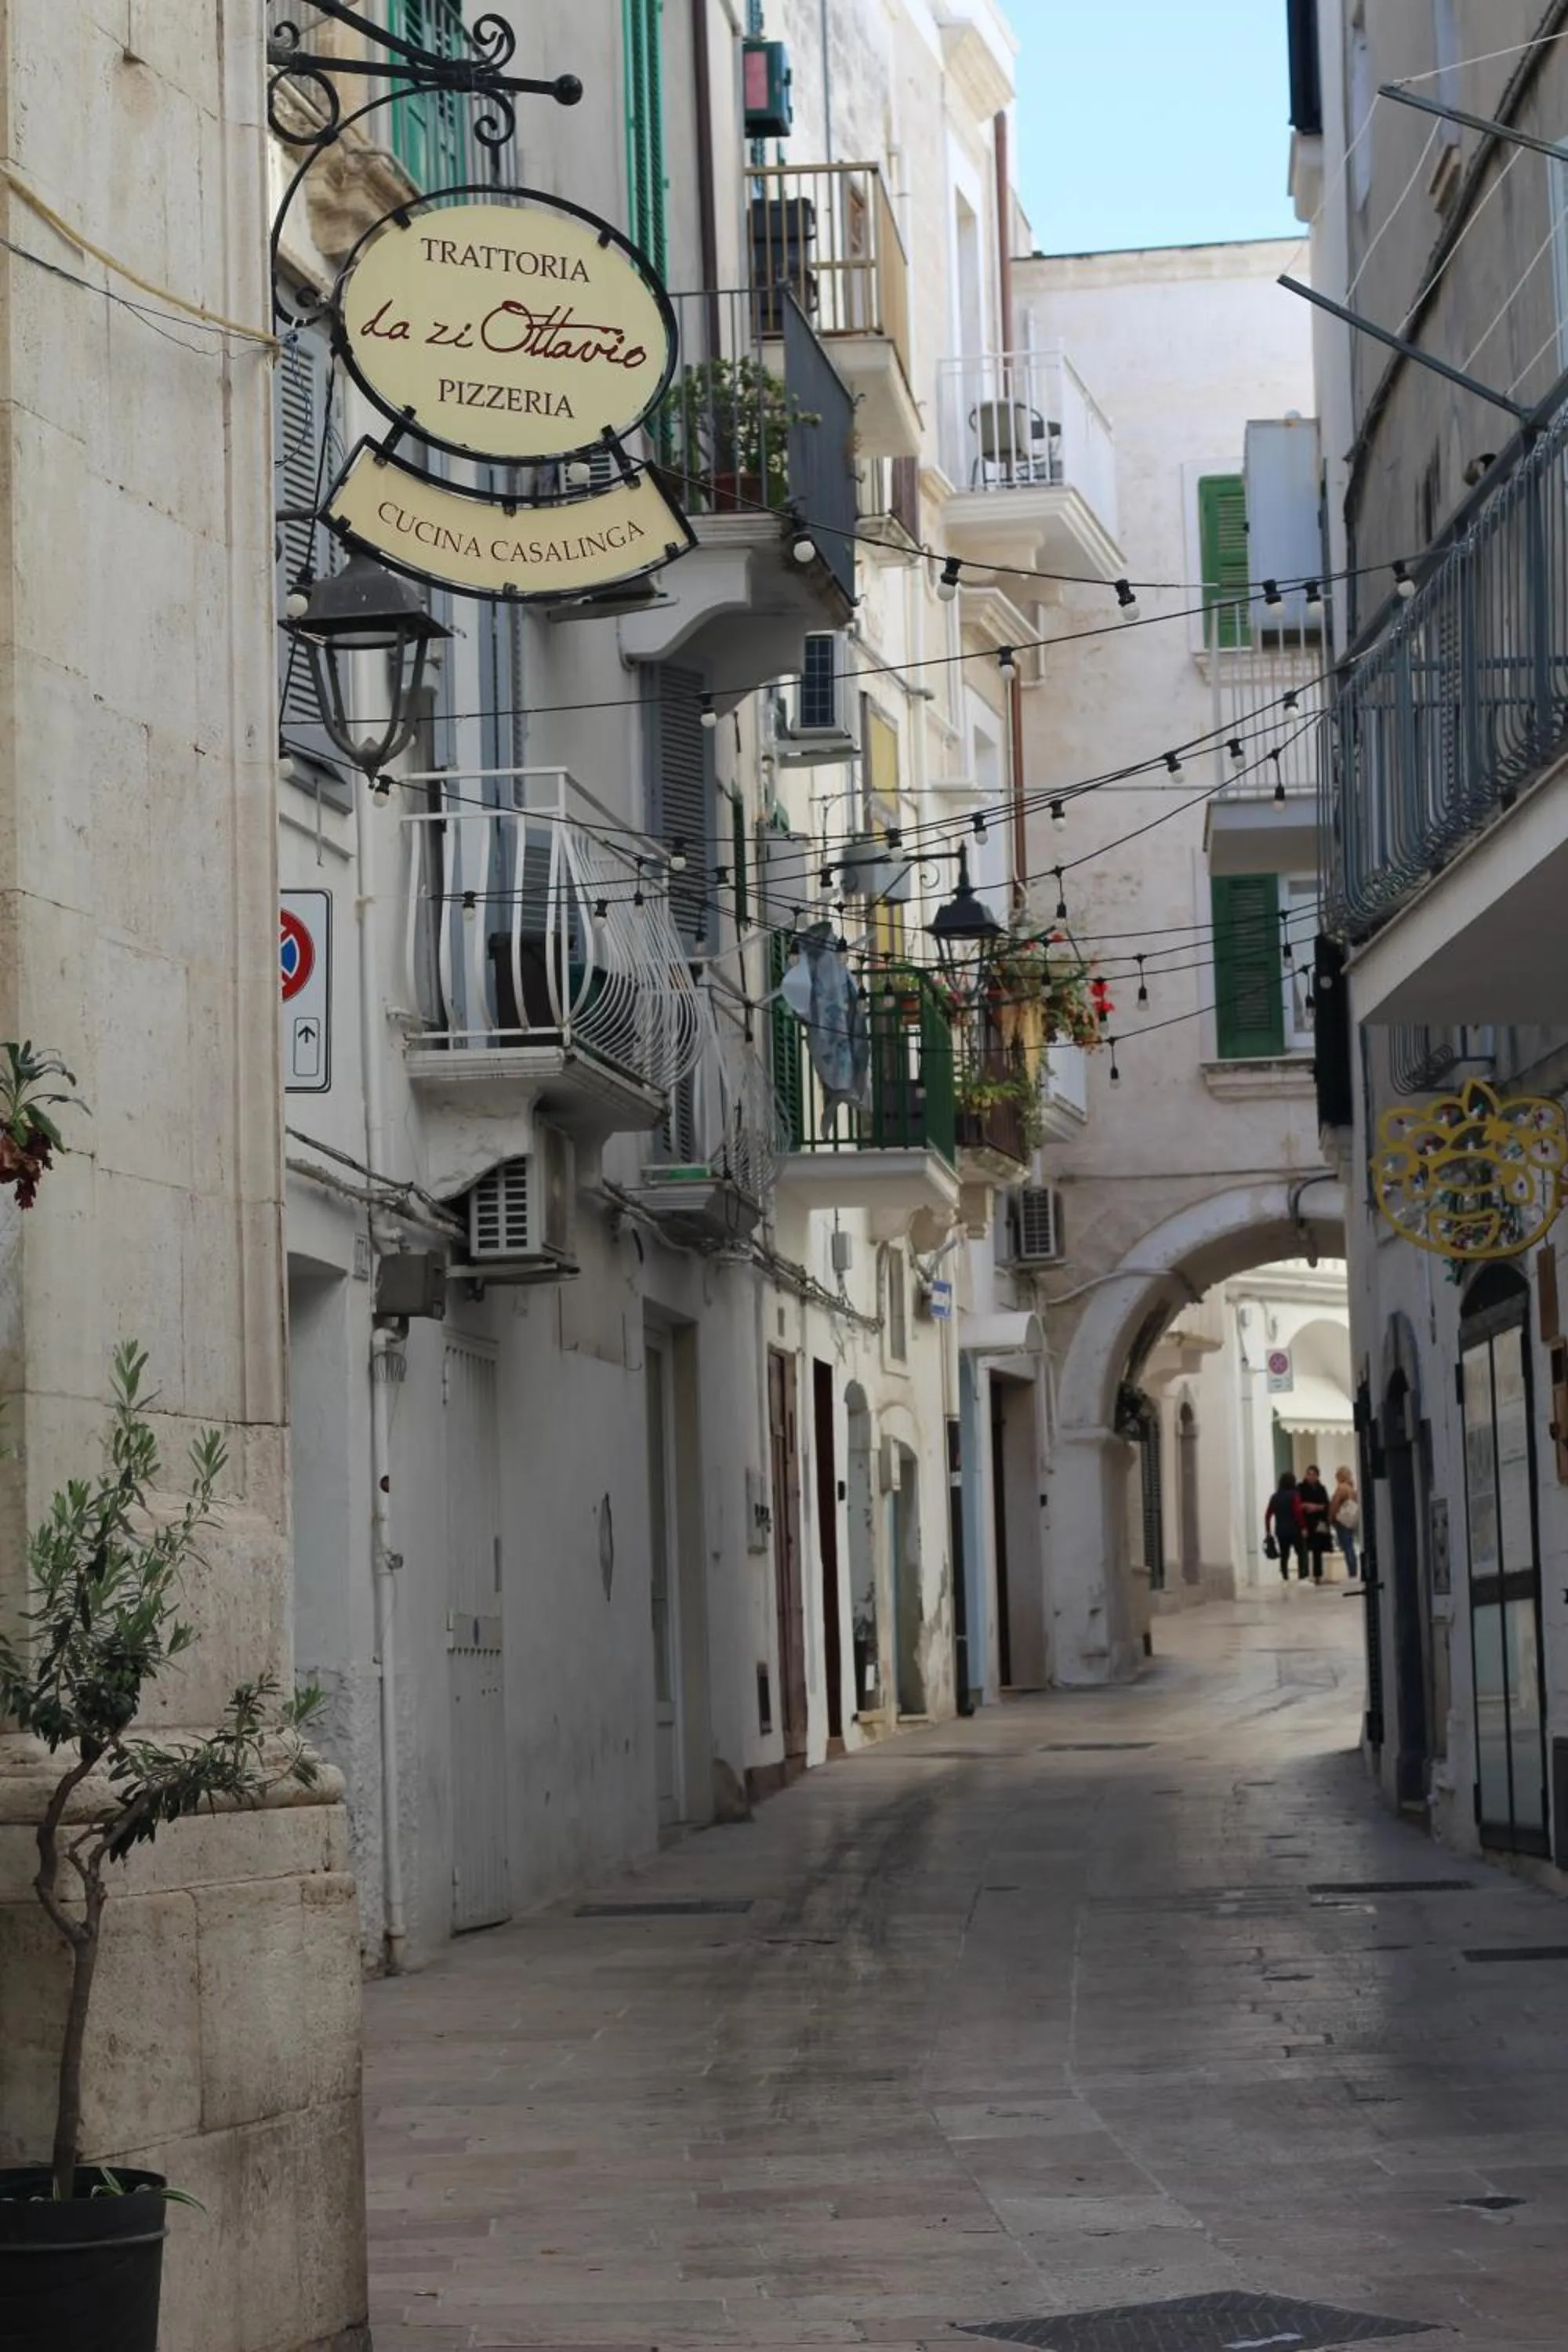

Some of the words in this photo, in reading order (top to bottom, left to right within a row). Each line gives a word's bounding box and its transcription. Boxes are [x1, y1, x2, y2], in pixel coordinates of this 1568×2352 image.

[420, 238, 590, 283] TRATTORIA
[425, 321, 474, 348] zi
[481, 300, 647, 368] Ottavio
[438, 379, 575, 419] PIZZERIA
[377, 501, 481, 557] CUCINA
[491, 519, 645, 564] CASALINGA
